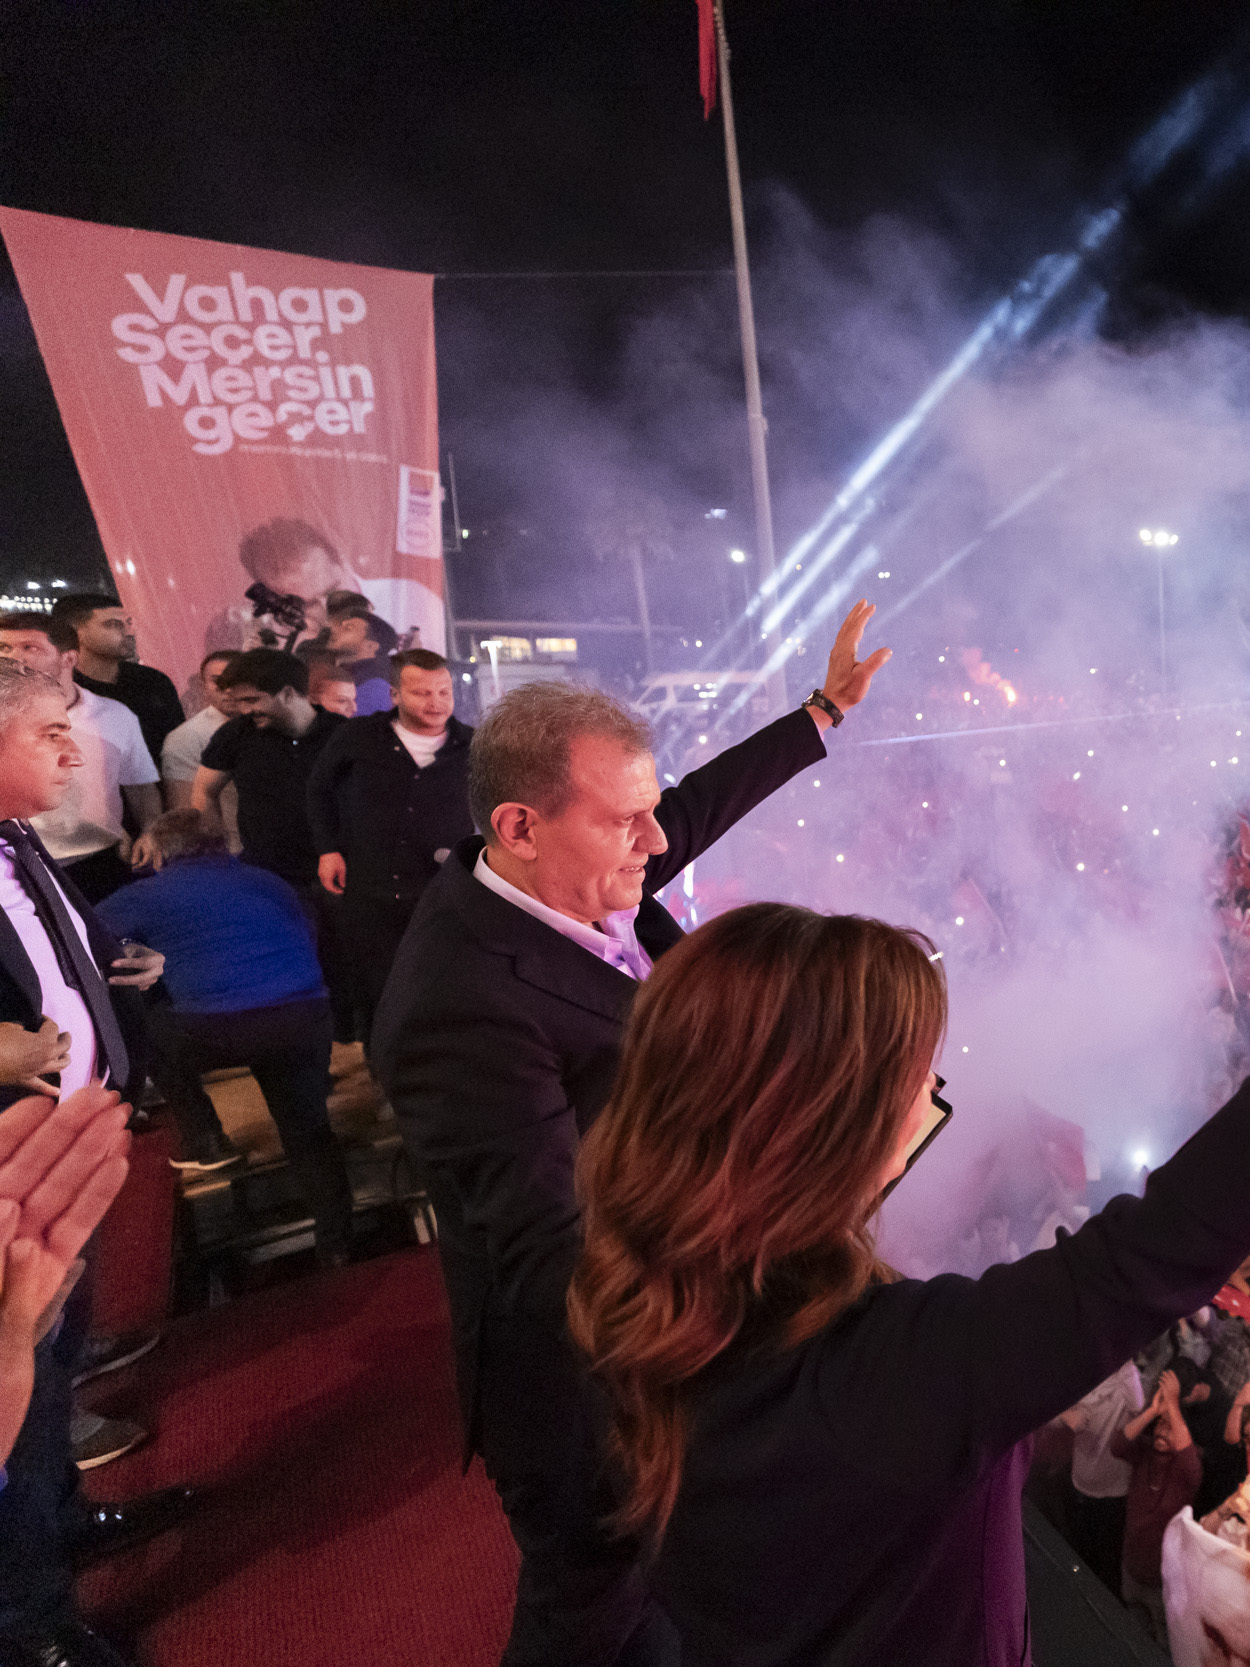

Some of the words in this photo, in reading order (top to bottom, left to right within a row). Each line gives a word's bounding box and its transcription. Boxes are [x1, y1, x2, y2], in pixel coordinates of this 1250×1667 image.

[124, 271, 367, 335] Vahap
[138, 350, 375, 408] Mersin
[183, 399, 375, 456] geçer
